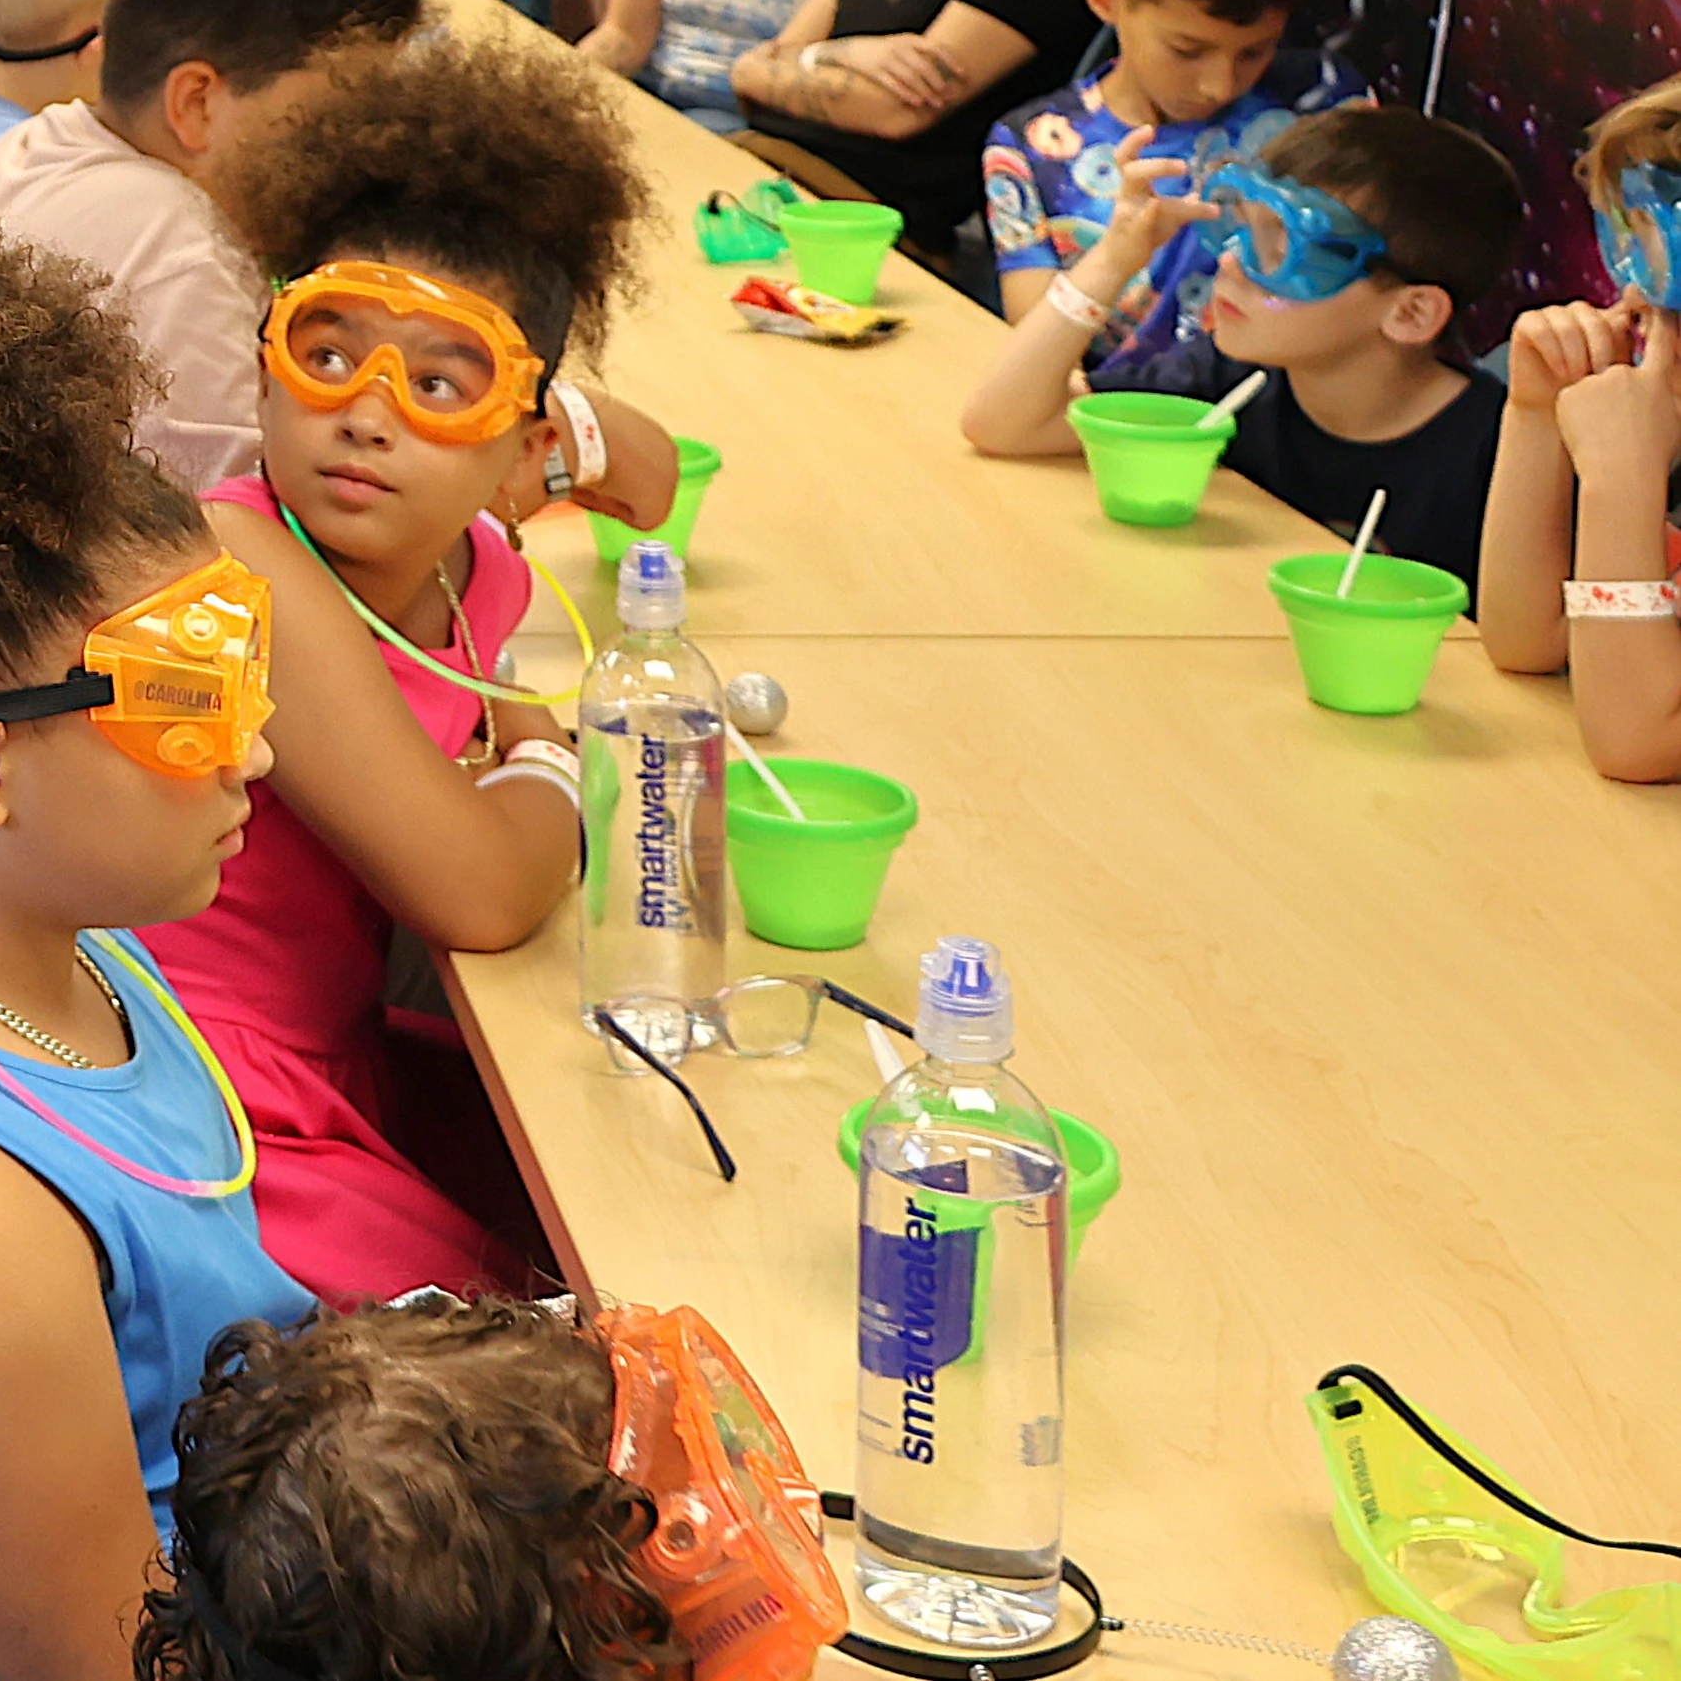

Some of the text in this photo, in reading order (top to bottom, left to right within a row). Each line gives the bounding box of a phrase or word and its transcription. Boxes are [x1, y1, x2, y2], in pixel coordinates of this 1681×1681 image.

[144, 682, 222, 712] CAROLINA
[635, 732, 667, 929] smartwater
[897, 1197, 938, 1466] smartwater
